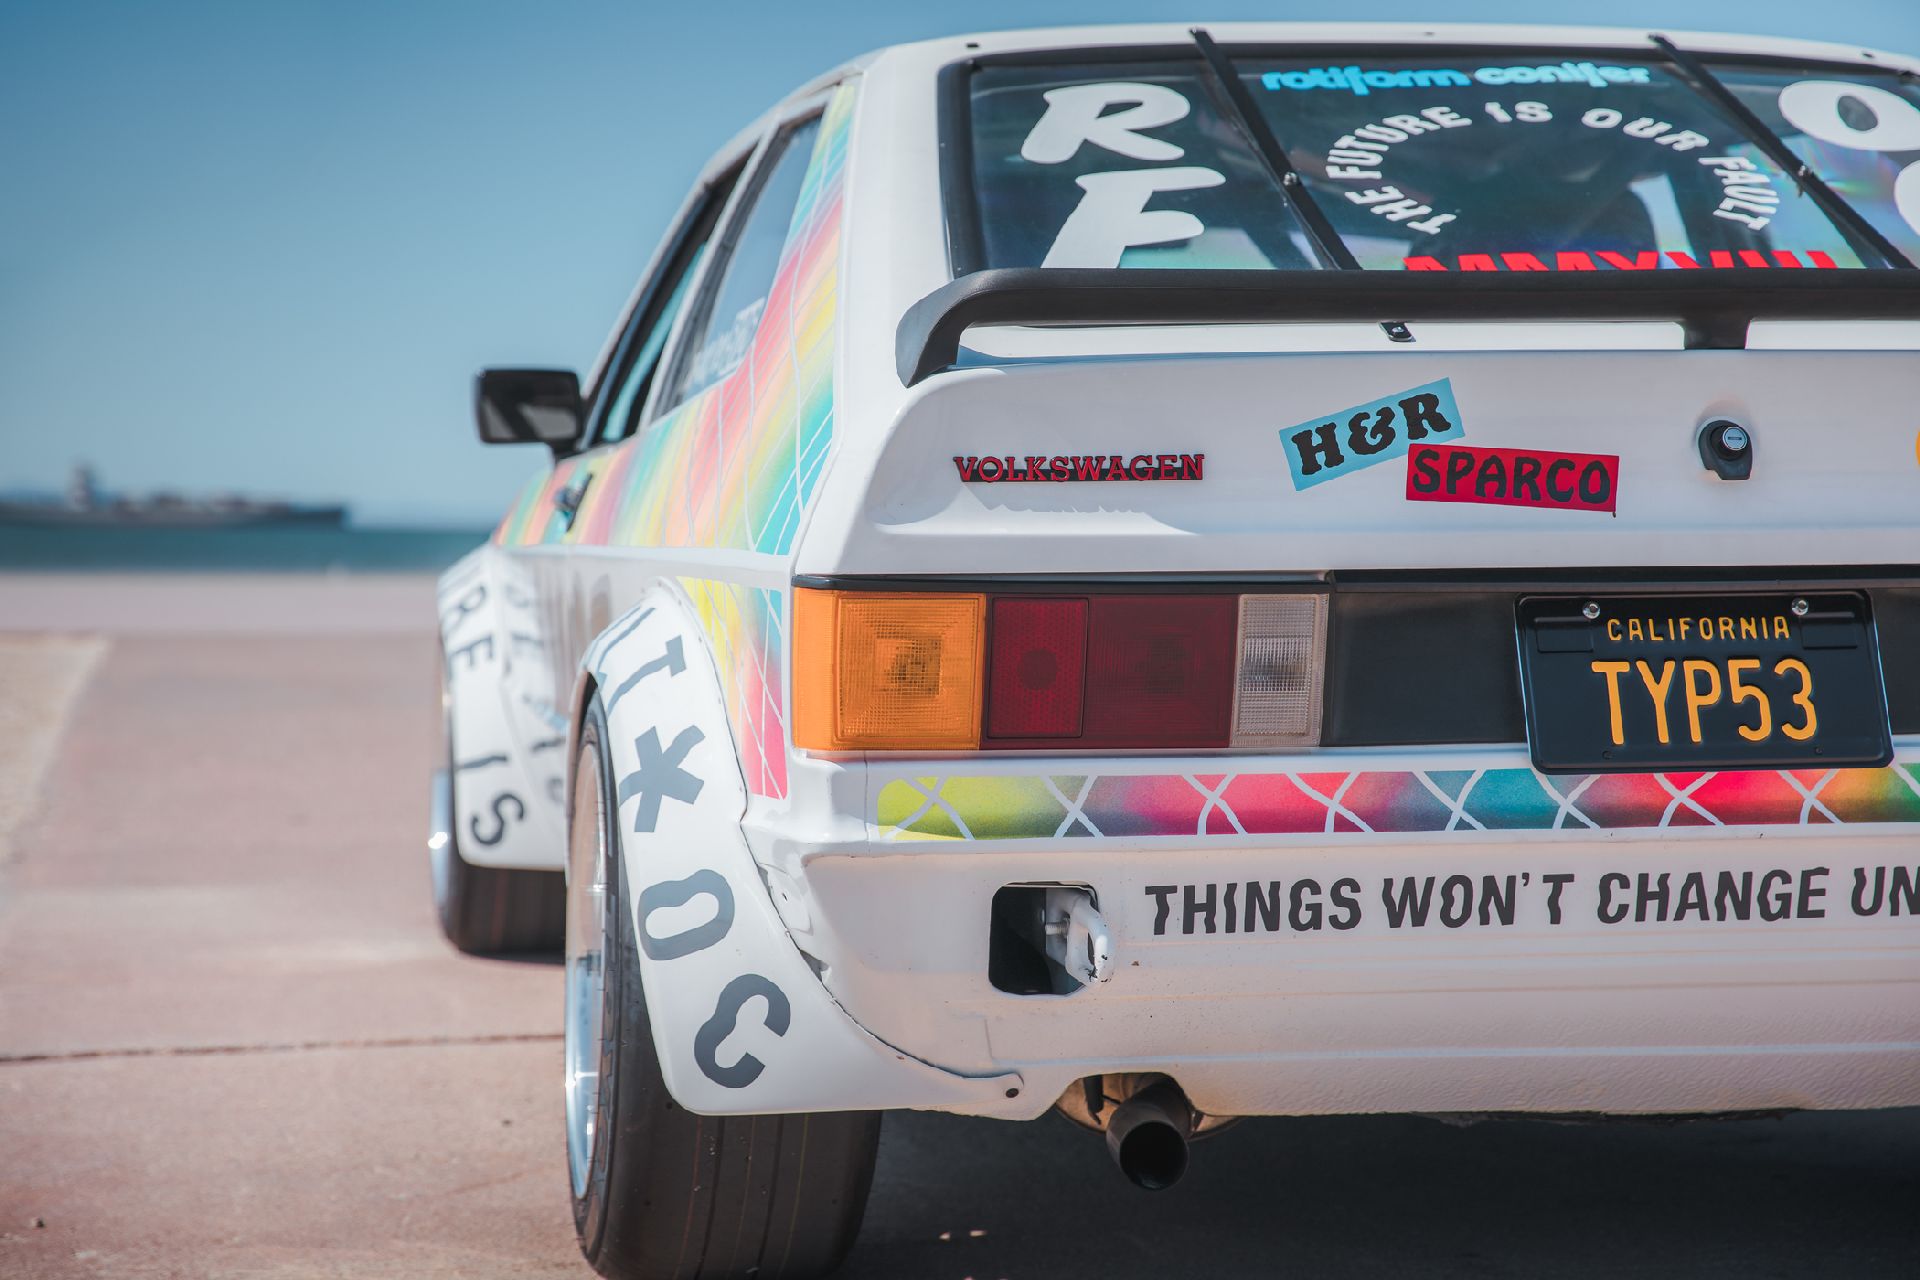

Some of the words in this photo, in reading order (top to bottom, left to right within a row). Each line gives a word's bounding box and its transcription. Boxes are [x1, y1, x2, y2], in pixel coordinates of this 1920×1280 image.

[1260, 65, 1472, 96] rotiform
[1474, 61, 1652, 88] conifer
[1020, 82, 1191, 164] R
[1485, 101, 1553, 123] IS
[1581, 107, 1711, 151] OUR
[1325, 106, 1473, 180] FUTURE
[1344, 185, 1458, 235] THE
[1698, 155, 1781, 231] FAULT
[1290, 391, 1453, 477] H&R
[953, 453, 1206, 483] VOLKSWAGEN
[1411, 447, 1612, 506] SPARCO
[1606, 615, 1791, 642] CALIFORNIA
[1591, 657, 1819, 746] TYP53
[1144, 876, 1363, 936] THINGS
[1381, 870, 1576, 929] WON'T
[1597, 866, 1830, 926] CHANGE
